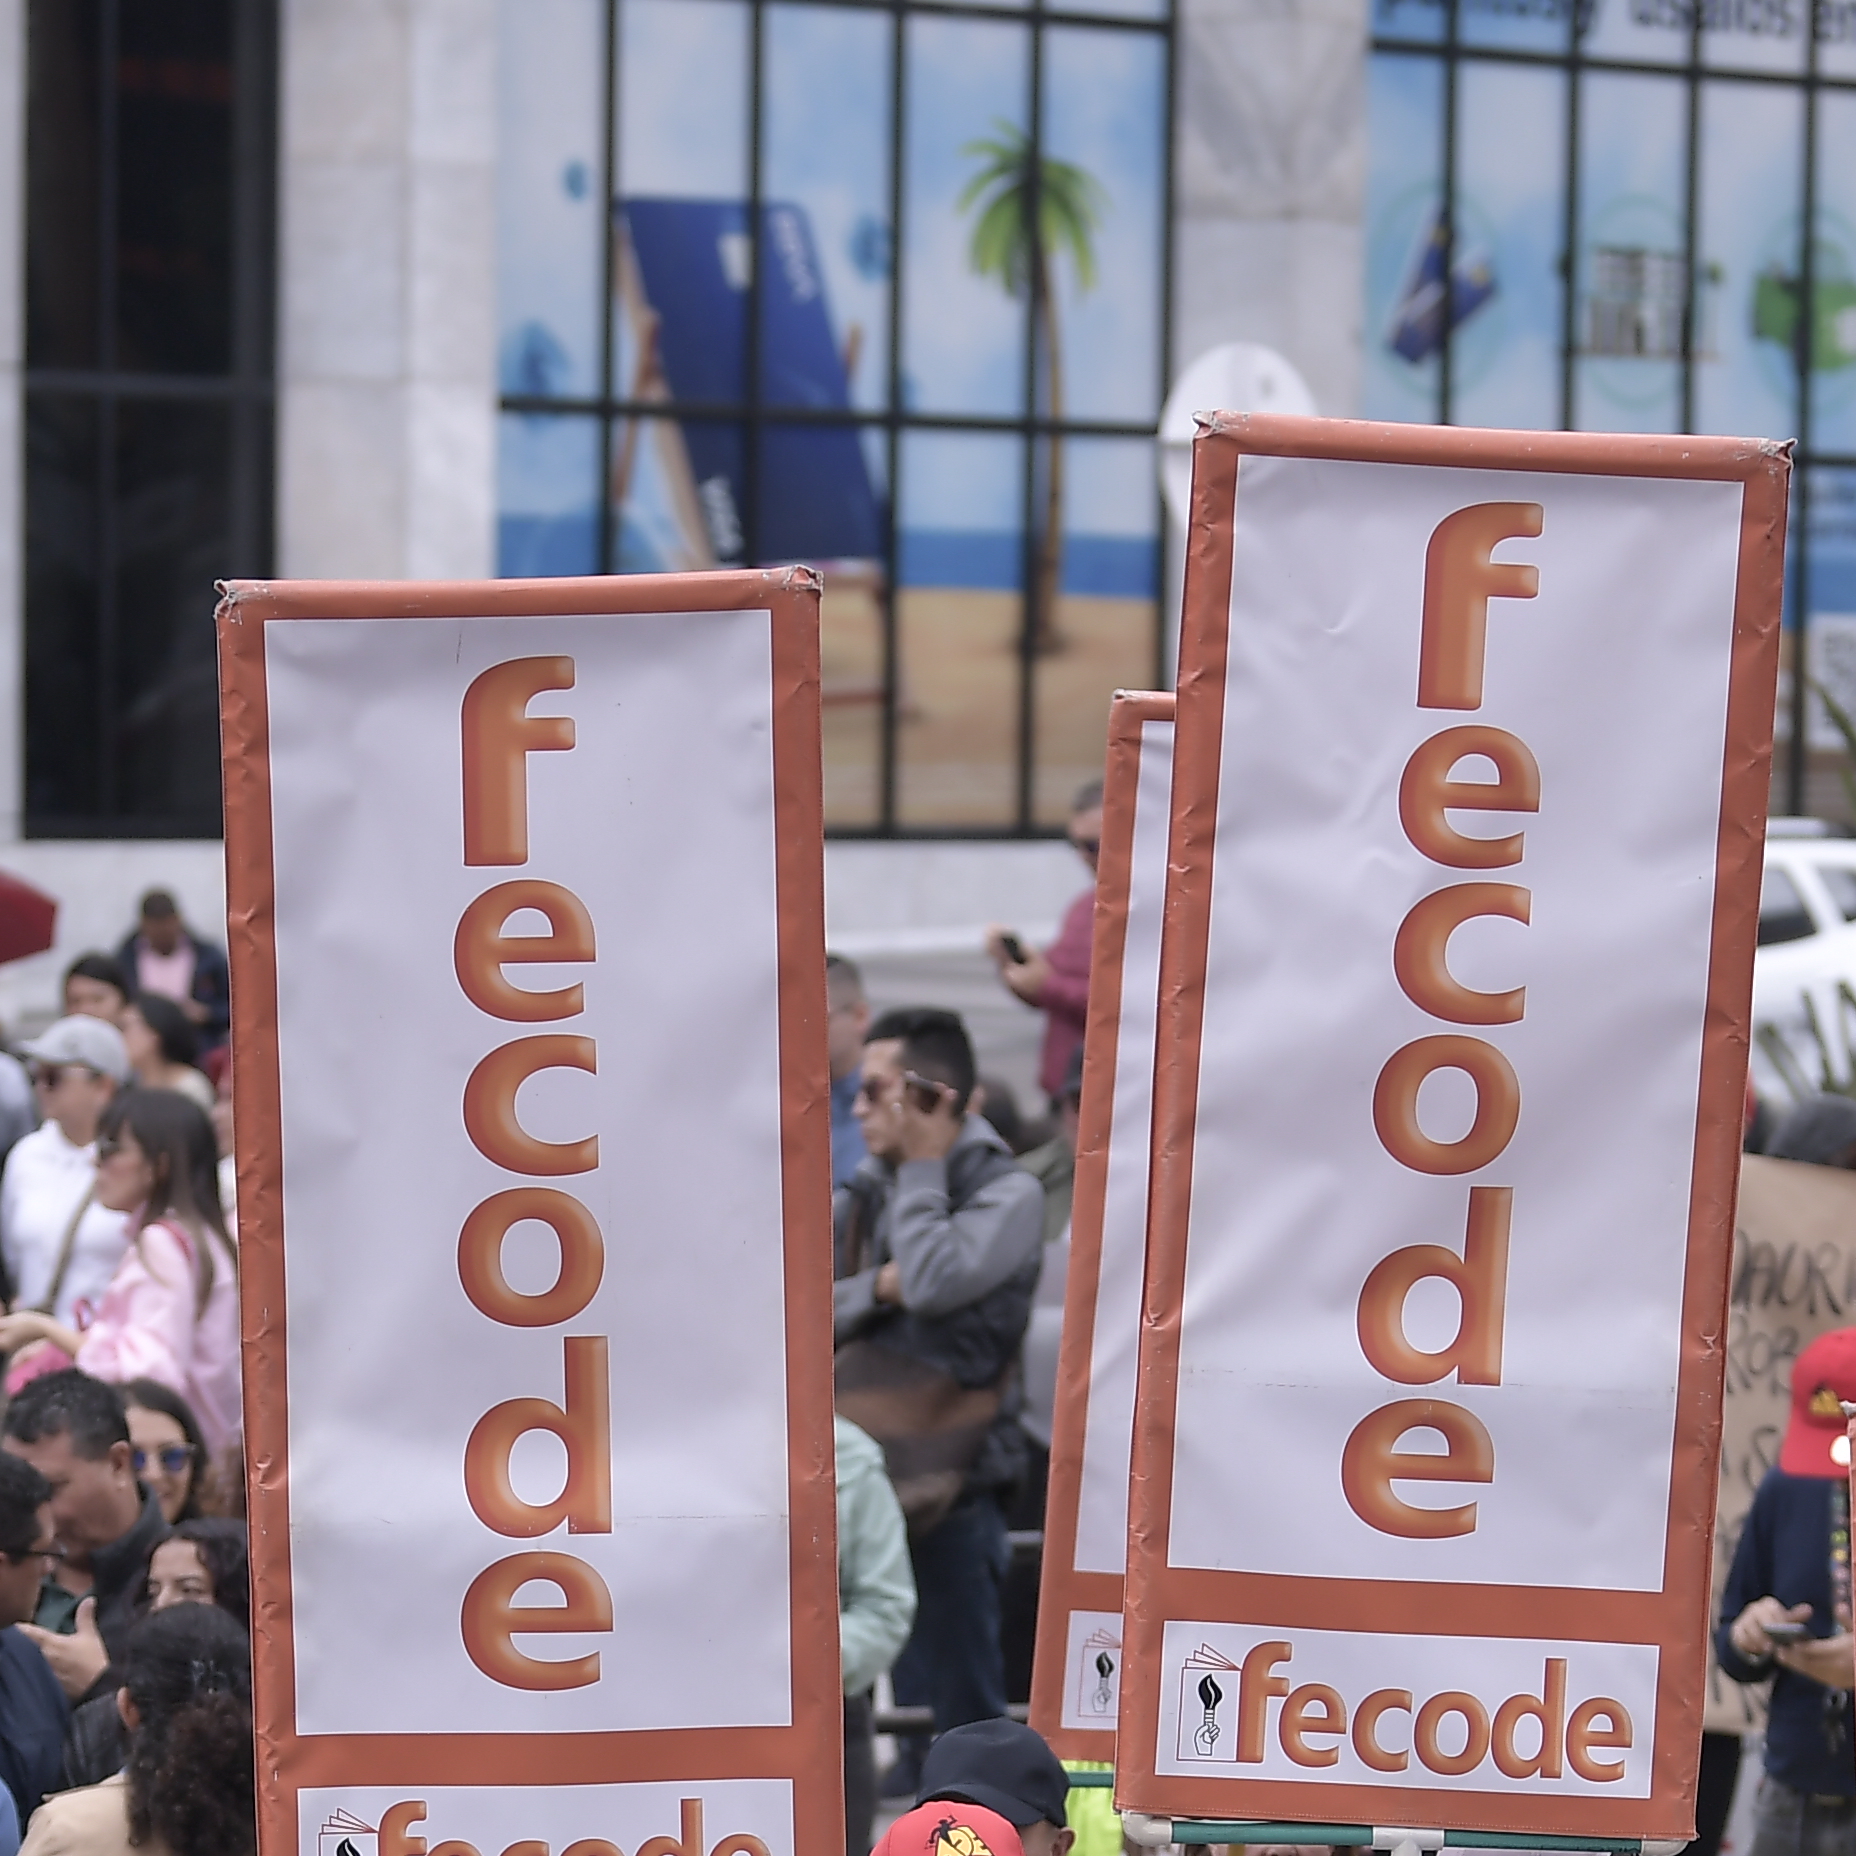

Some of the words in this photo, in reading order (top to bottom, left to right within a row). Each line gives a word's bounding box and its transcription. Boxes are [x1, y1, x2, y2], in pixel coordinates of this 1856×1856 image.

[452, 655, 614, 1693] fecode
[1340, 501, 1543, 1541] fecode
[1234, 1639, 1634, 1784] fecode
